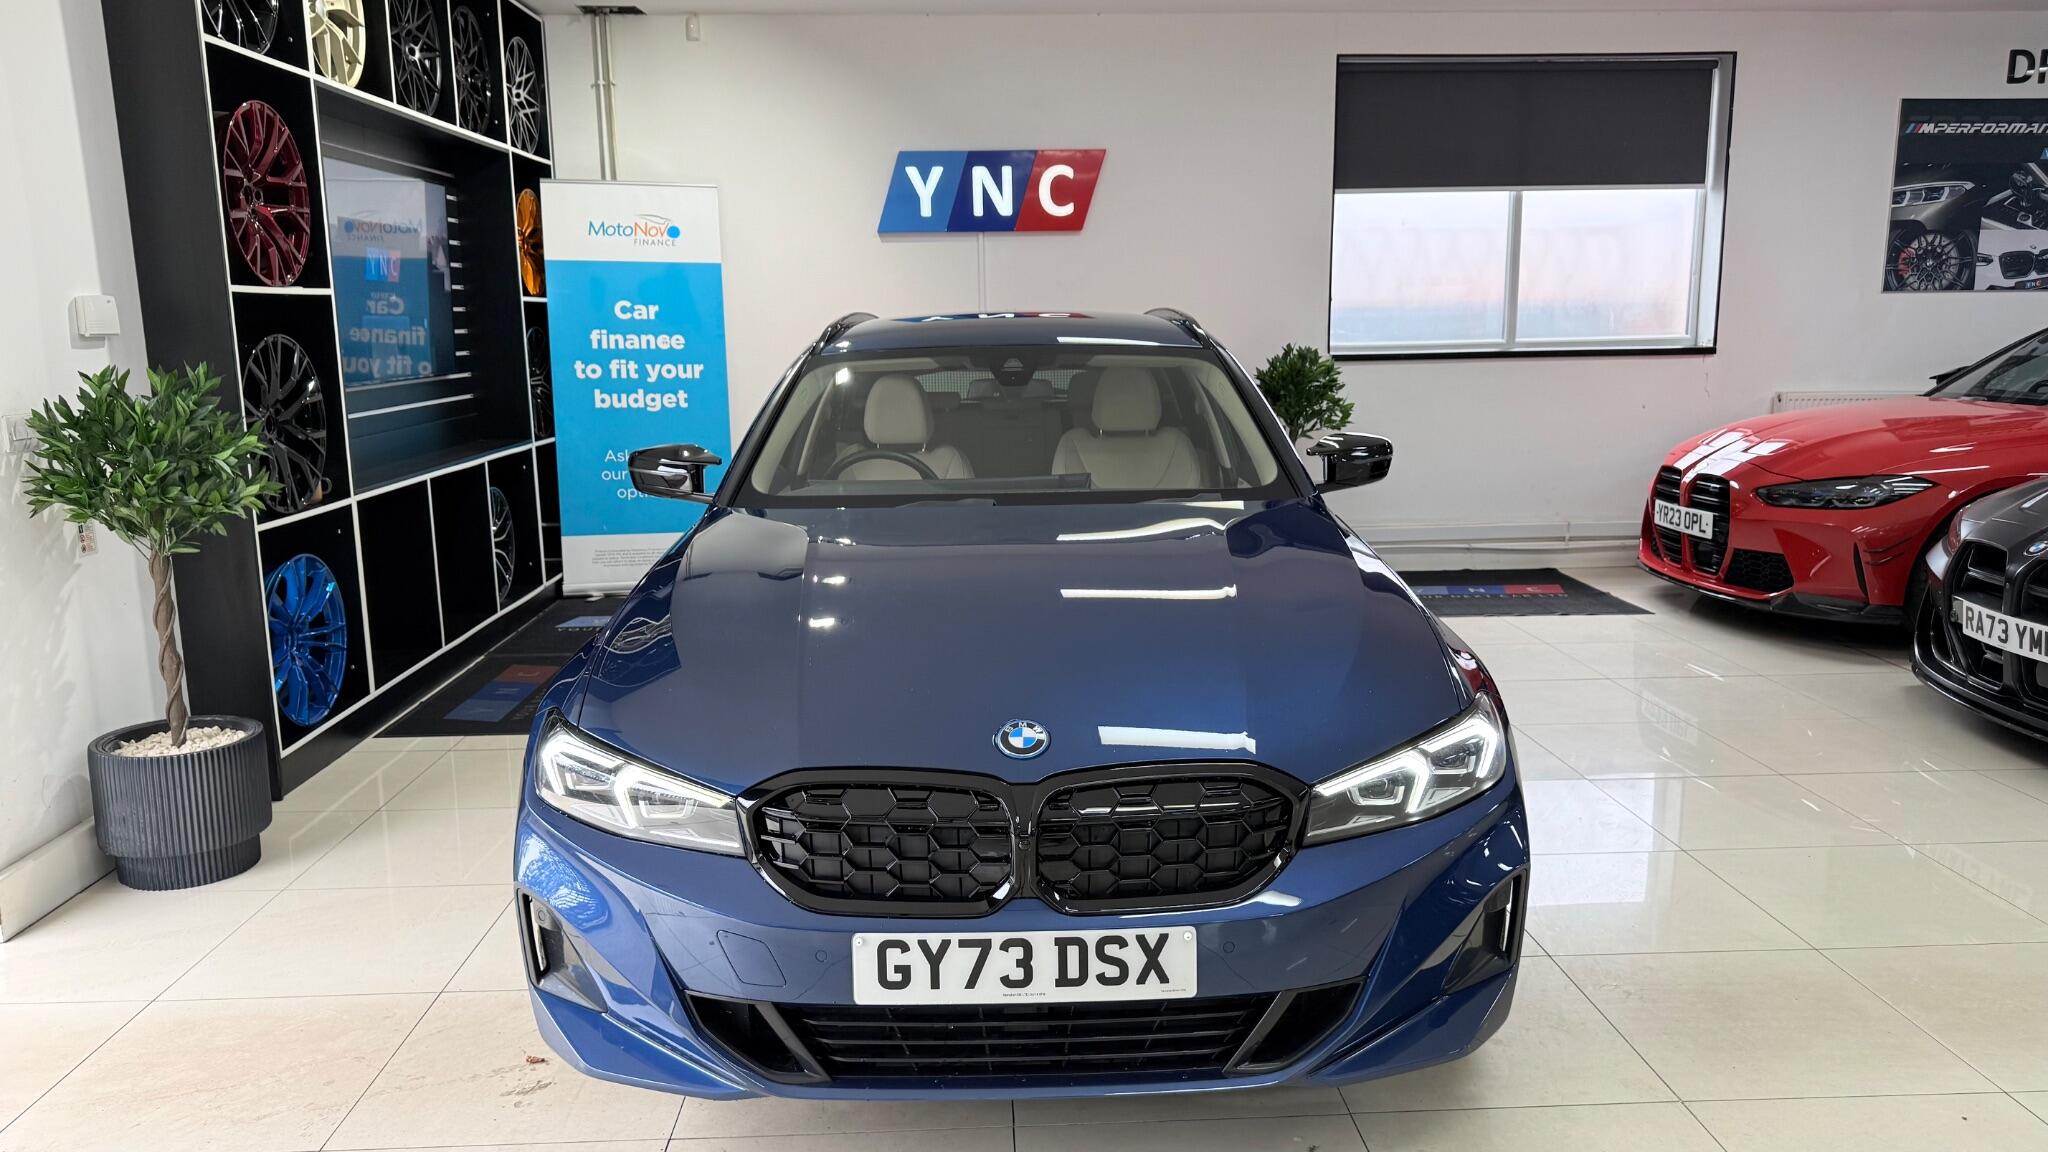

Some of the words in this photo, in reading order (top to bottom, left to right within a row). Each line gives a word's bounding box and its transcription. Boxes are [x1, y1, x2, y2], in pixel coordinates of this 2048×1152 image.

[905, 165, 1075, 217] YNC
[588, 220, 680, 239] MotoNovo
[634, 238, 677, 247] FINANCE
[614, 300, 659, 320] Car
[590, 328, 686, 350] finance
[574, 360, 602, 379] to
[609, 359, 639, 379] fit
[645, 363, 704, 383] your
[593, 388, 689, 412] budget
[601, 469, 628, 480] our
[1658, 503, 1682, 527] YR23
[1683, 511, 1706, 534] OPL
[1965, 605, 2009, 644] RA73
[1004, 721, 1045, 740] BMW
[877, 937, 1034, 990] GY73
[1054, 933, 1170, 988] DSX
